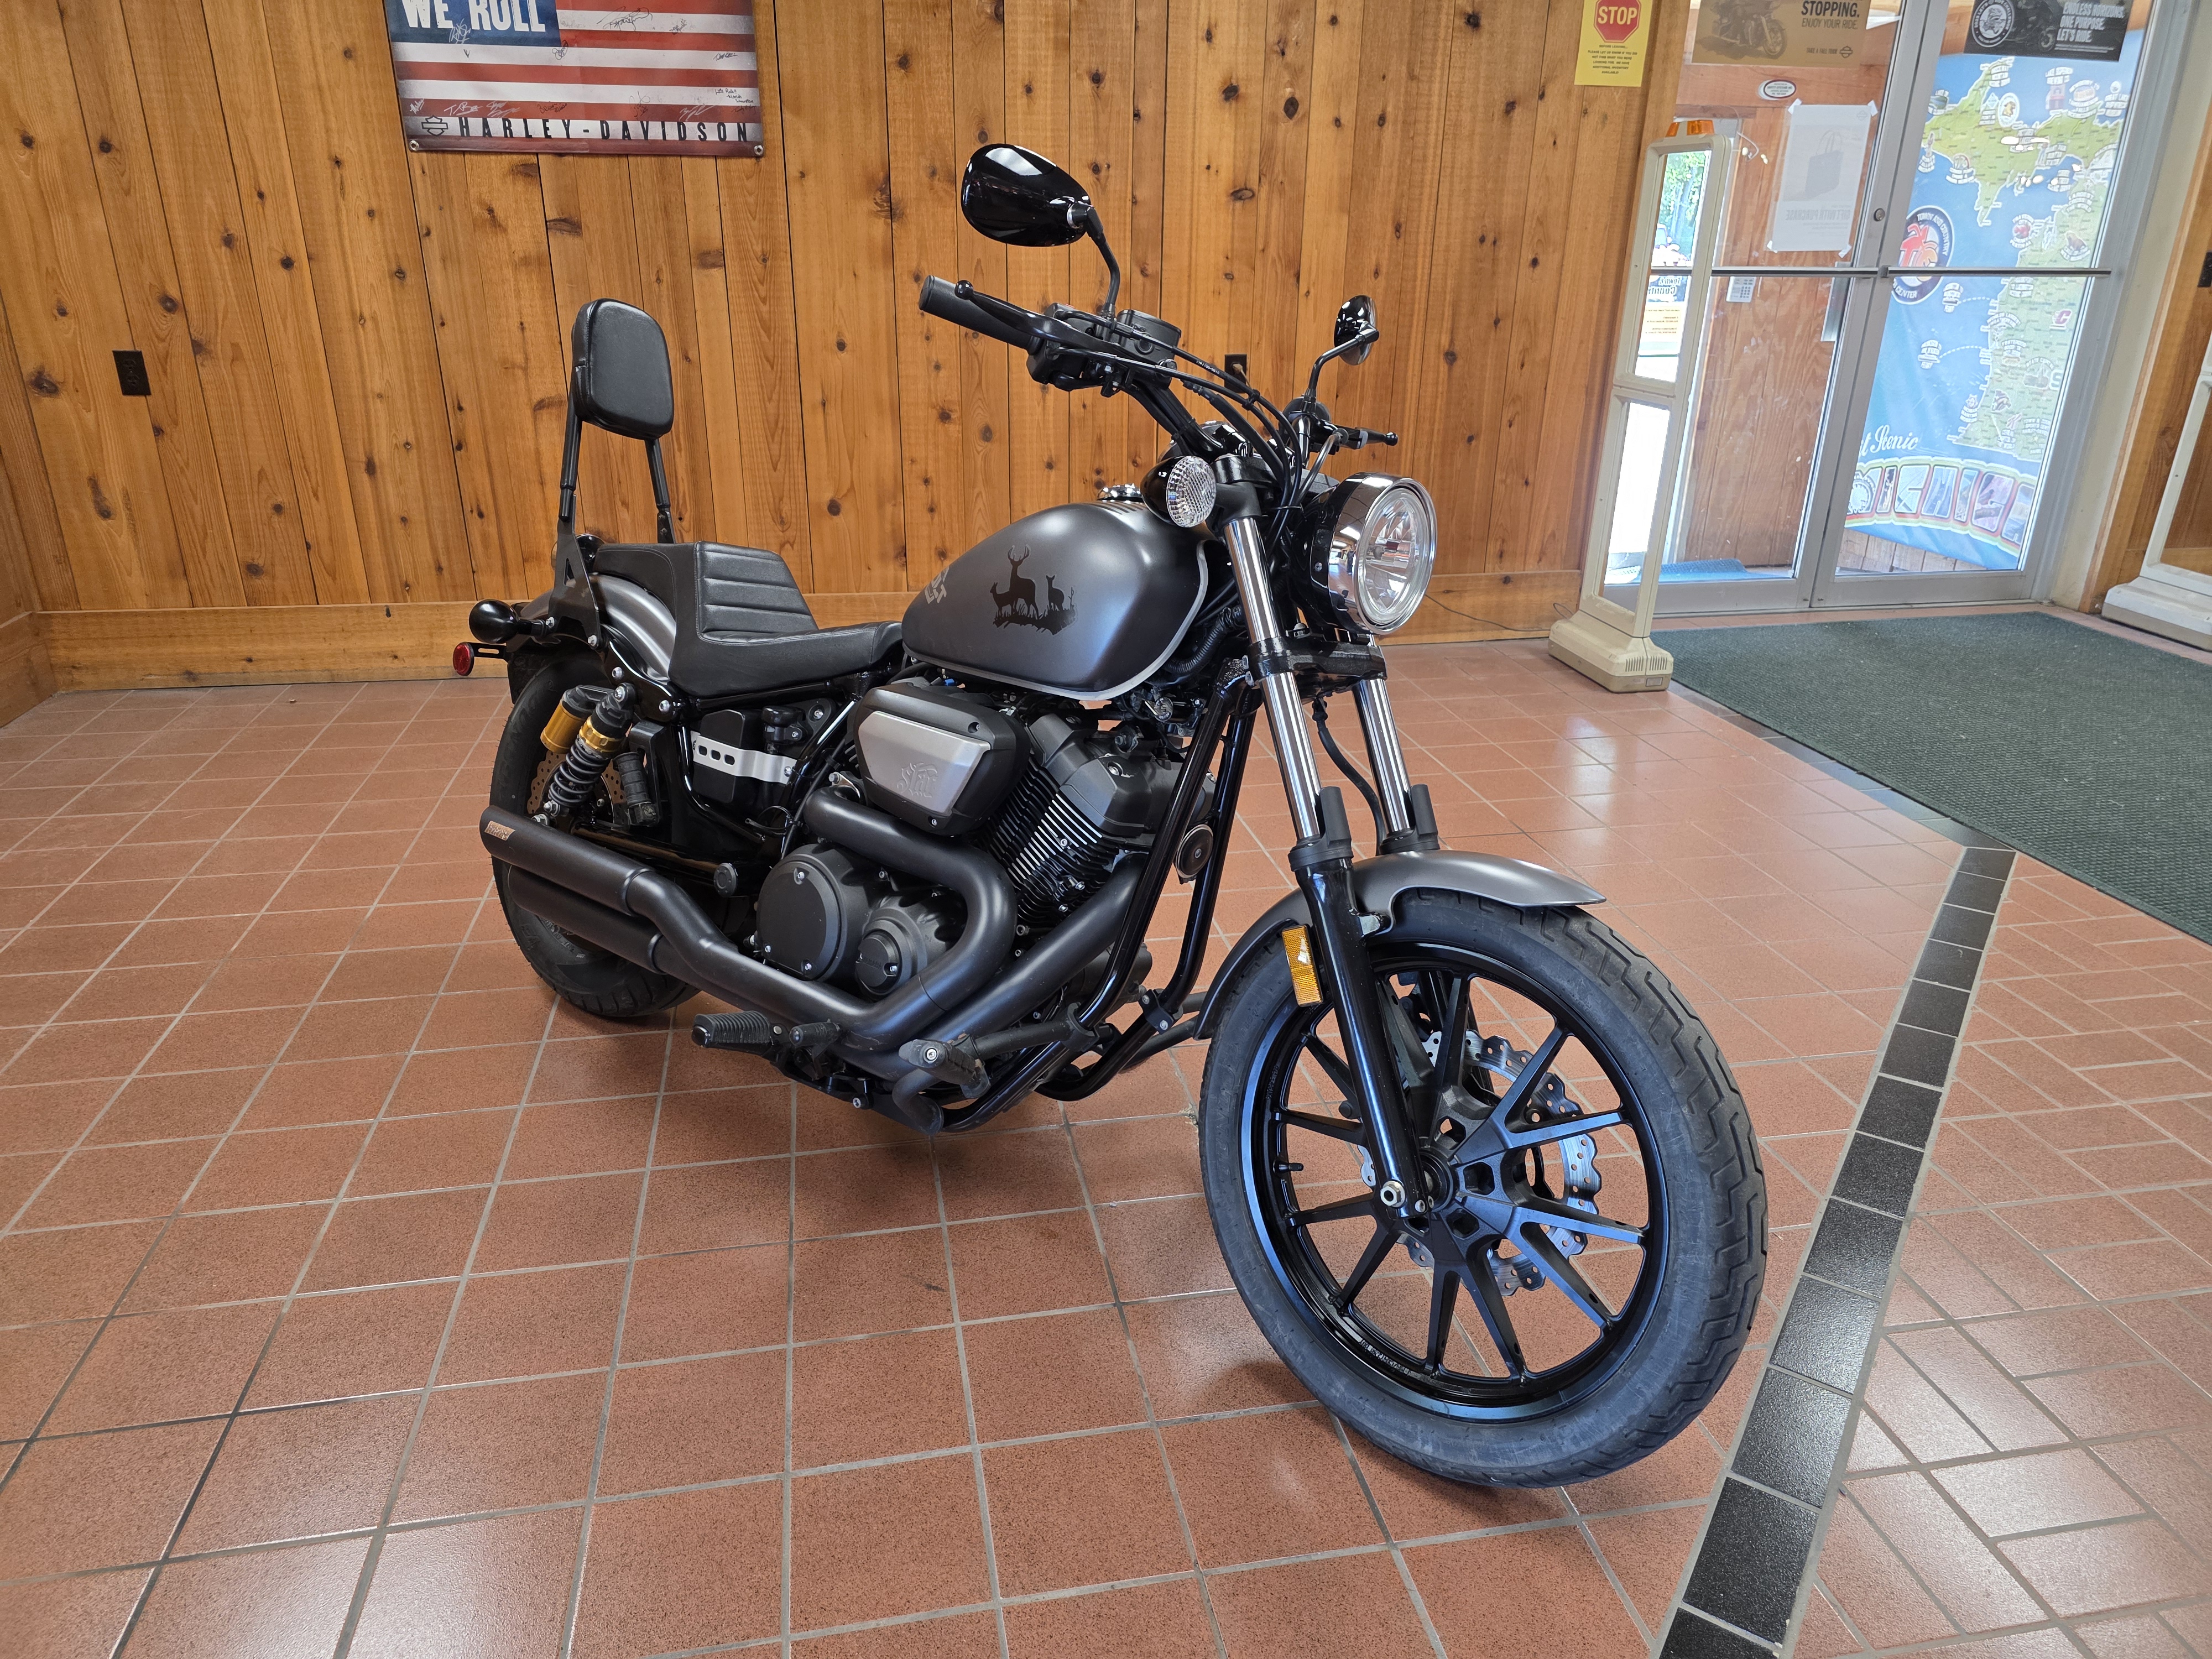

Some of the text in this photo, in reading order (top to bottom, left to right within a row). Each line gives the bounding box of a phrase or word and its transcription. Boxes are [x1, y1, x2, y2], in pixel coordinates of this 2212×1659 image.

[403, 0, 453, 29] WE
[468, 0, 545, 32] ROLL
[1598, 6, 1637, 25] STOP
[1801, 1, 1860, 18] STOPPING.
[2063, 2, 2092, 15] ENDLESS
[1802, 18, 1822, 28] ENJOY
[1823, 18, 1841, 28] YOUR
[2060, 15, 2075, 28] ONE
[458, 117, 748, 142] HARLEY-DAVIDSON
[1895, 286, 1918, 299] CENTER
[1870, 424, 1918, 453] Scenic
